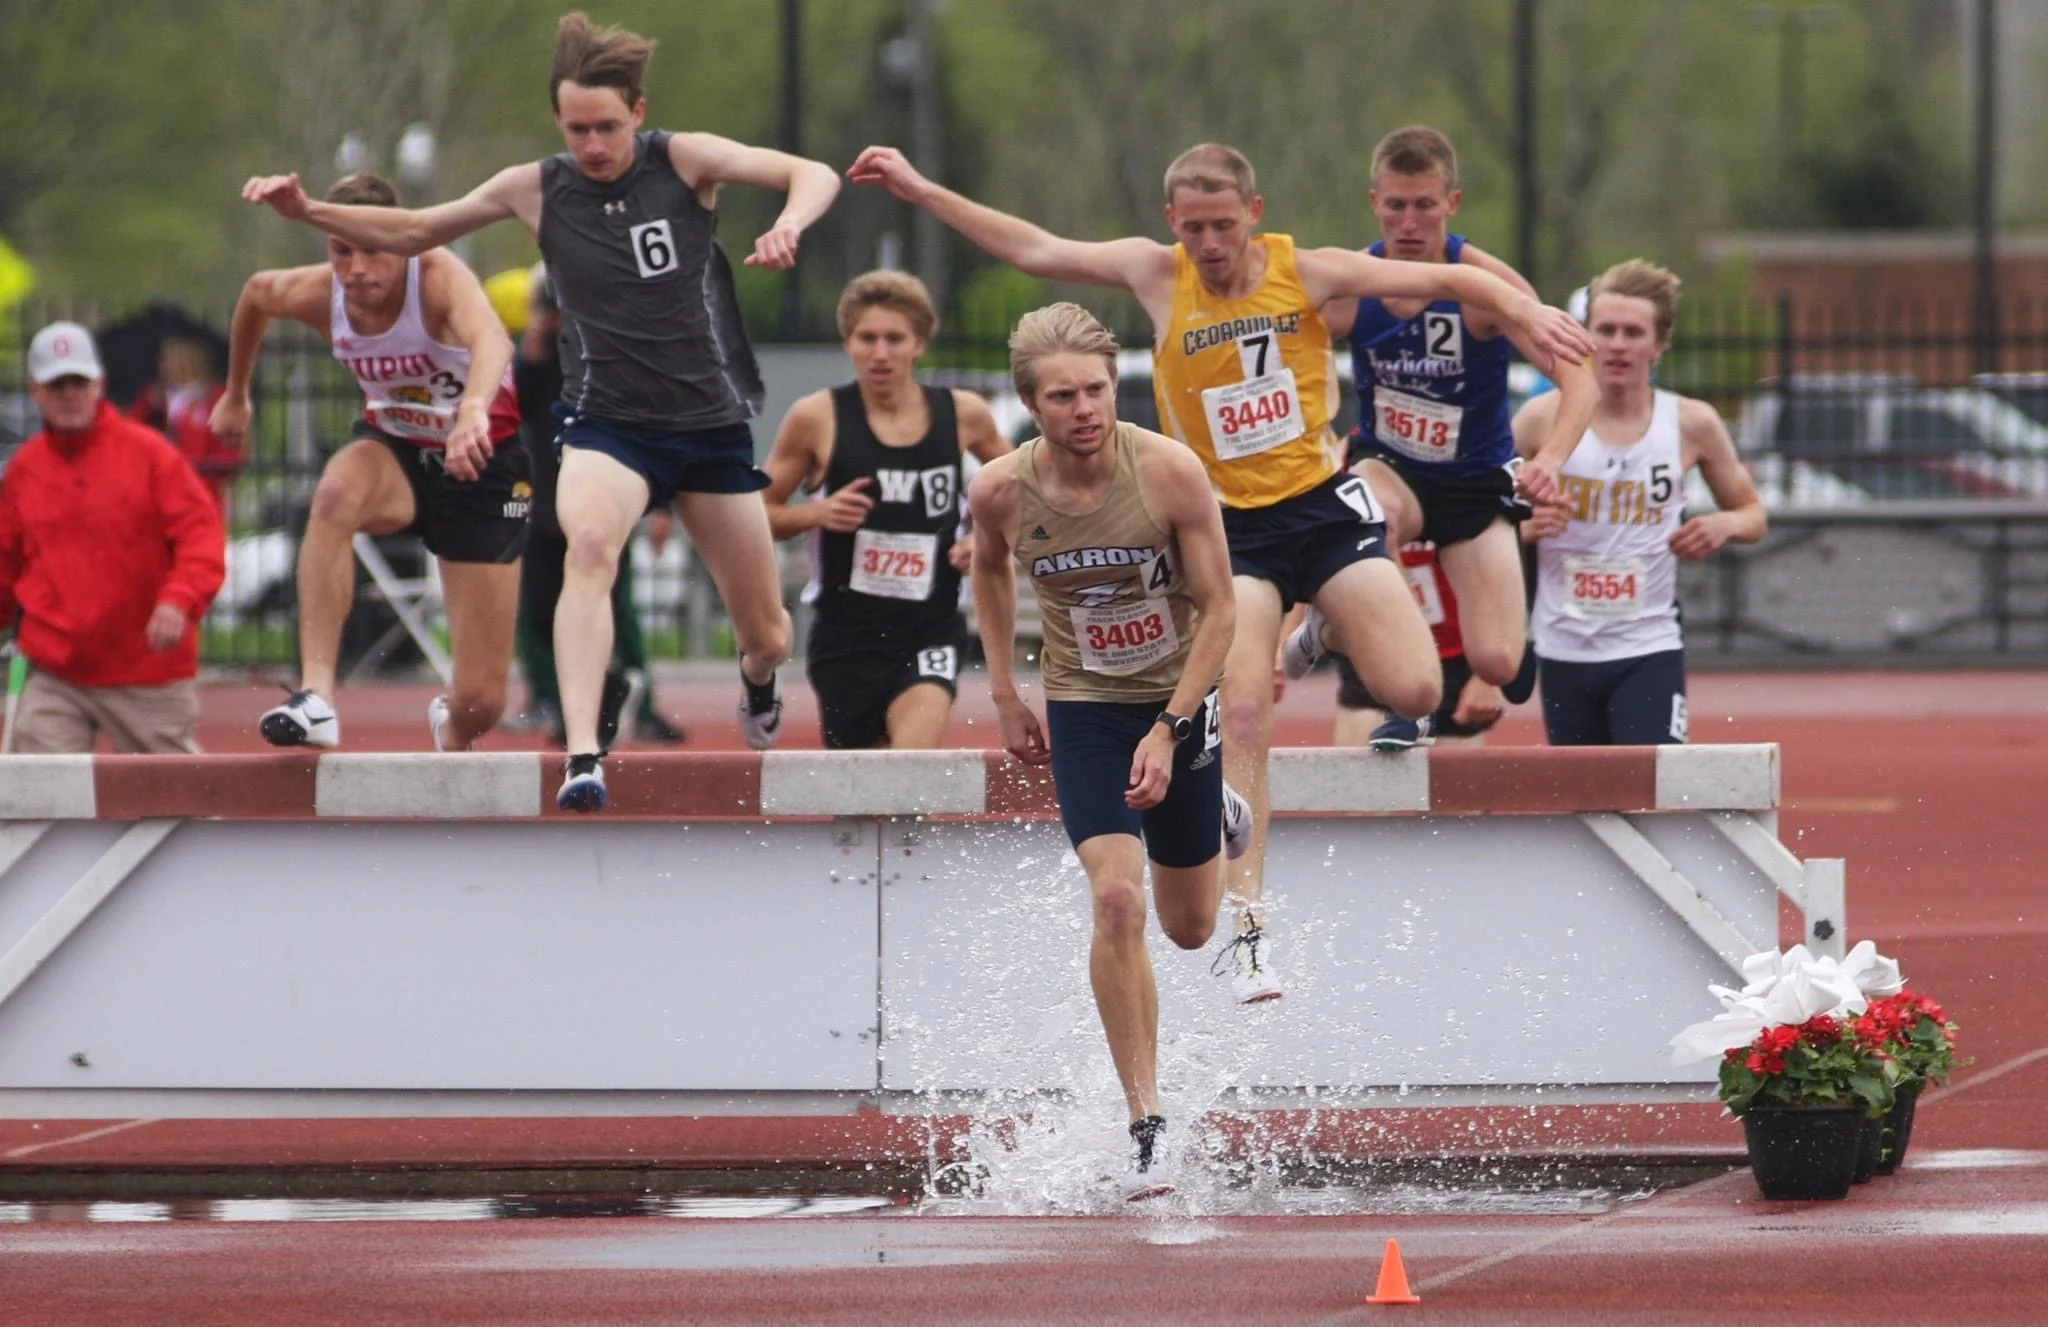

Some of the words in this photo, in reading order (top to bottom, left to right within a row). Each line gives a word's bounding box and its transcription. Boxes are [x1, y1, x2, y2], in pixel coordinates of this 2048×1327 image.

[639, 226, 670, 271] 6
[1184, 313, 1299, 355] CEDARVILLE
[1429, 316, 1456, 357] 2
[1242, 334, 1269, 377] 7
[430, 371, 464, 399] 3
[1218, 390, 1289, 435] 3440
[1384, 406, 1450, 447] 3513
[877, 470, 918, 502] W
[931, 473, 949, 511] 8
[1342, 483, 1373, 521] 7
[1651, 464, 1672, 503] 5
[864, 549, 925, 577] 3725
[1032, 547, 1156, 577] AKRON
[1150, 554, 1172, 590] 4
[1575, 572, 1635, 599] 3554
[1086, 613, 1164, 650] 3403
[927, 650, 947, 672] 8
[1208, 695, 1219, 741] 4
